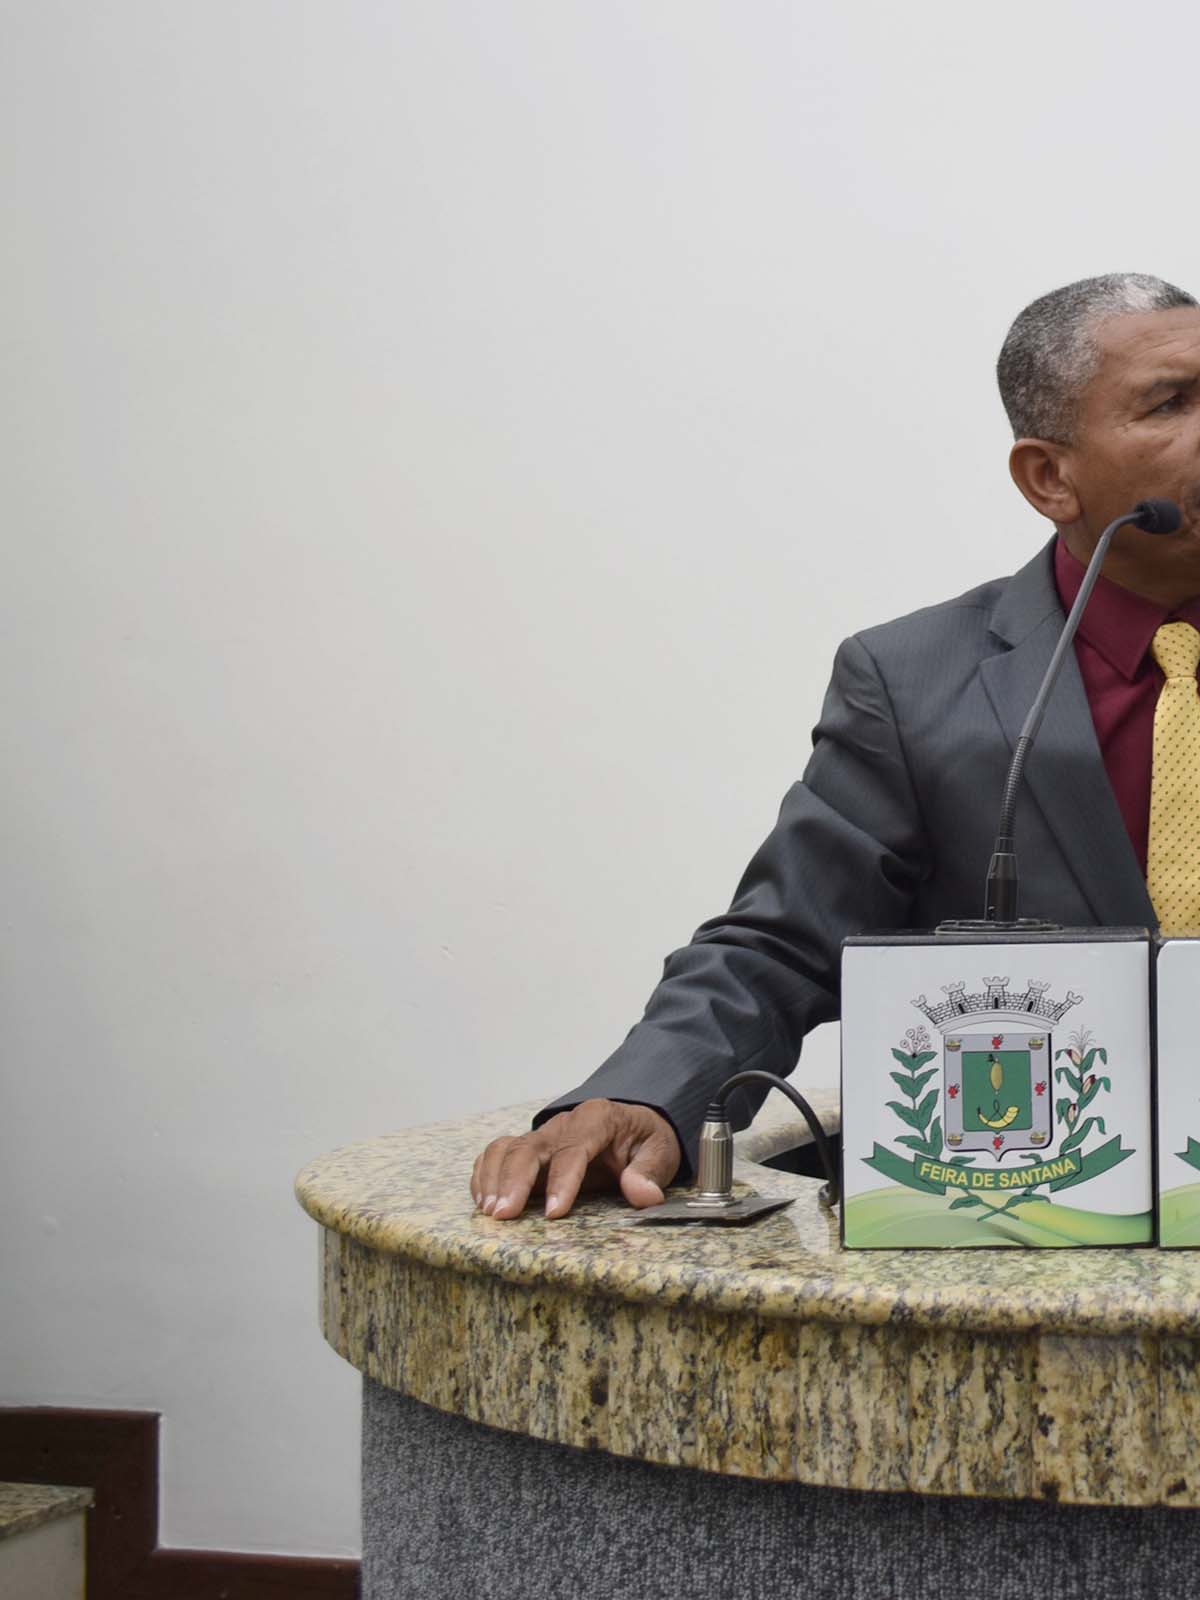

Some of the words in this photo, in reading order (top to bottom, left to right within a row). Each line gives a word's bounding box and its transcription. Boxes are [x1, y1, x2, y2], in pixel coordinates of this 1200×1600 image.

[920, 1161, 968, 1186] FEIRA
[972, 1172, 995, 1187] DE
[999, 1157, 1076, 1188] SANTANA
